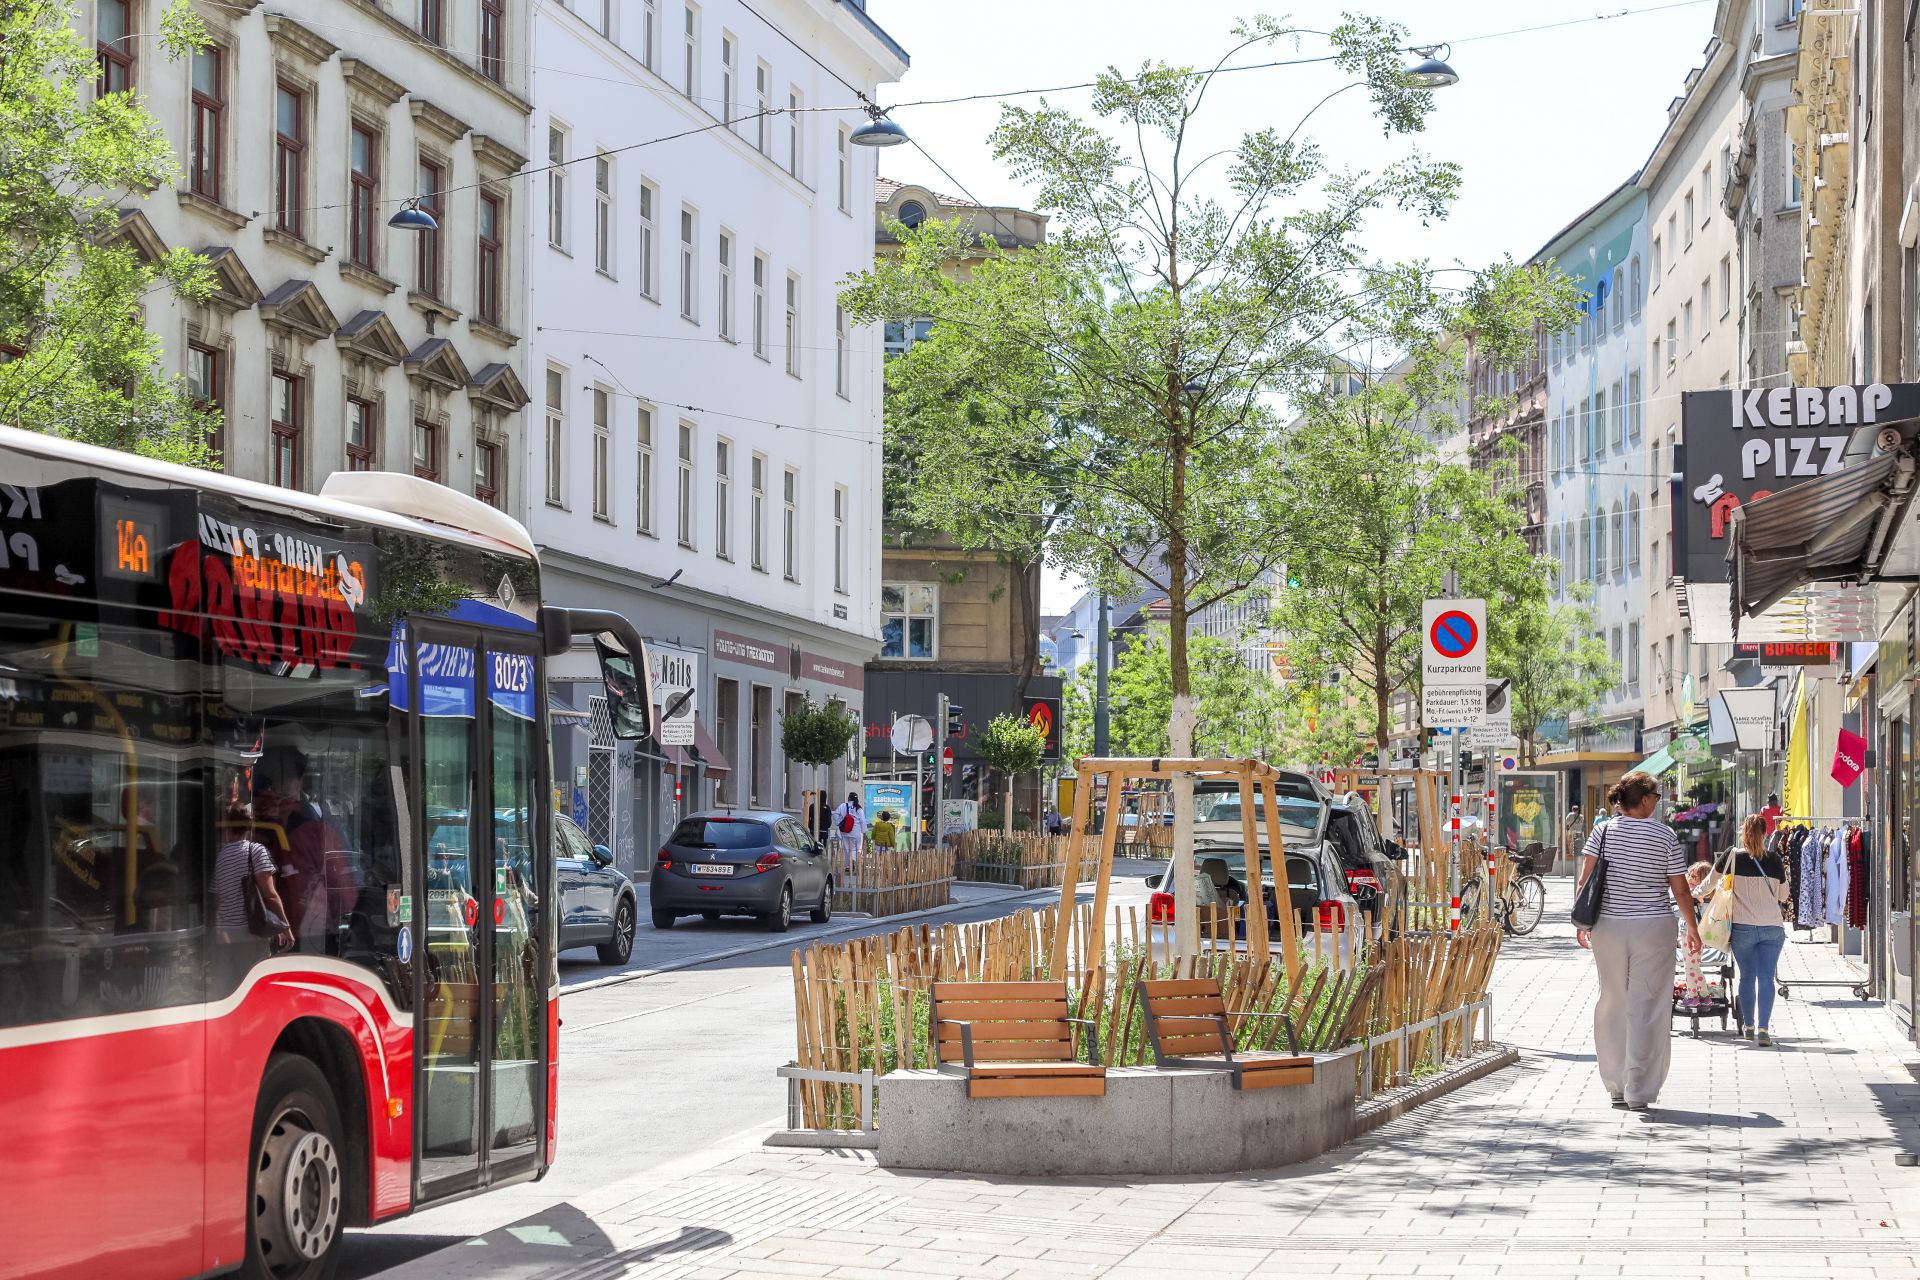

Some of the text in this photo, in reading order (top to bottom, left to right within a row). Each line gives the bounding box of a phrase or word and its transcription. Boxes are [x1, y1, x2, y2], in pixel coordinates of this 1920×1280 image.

[1732, 383, 1892, 428] KEBAP
[1742, 436, 1849, 479] PIZZ
[117, 519, 149, 573] 14A
[495, 655, 526, 692] 8023
[662, 654, 692, 688] Nails
[1427, 664, 1482, 674] Kurzparkzone
[1426, 689, 1482, 697] gebührenpflichtig
